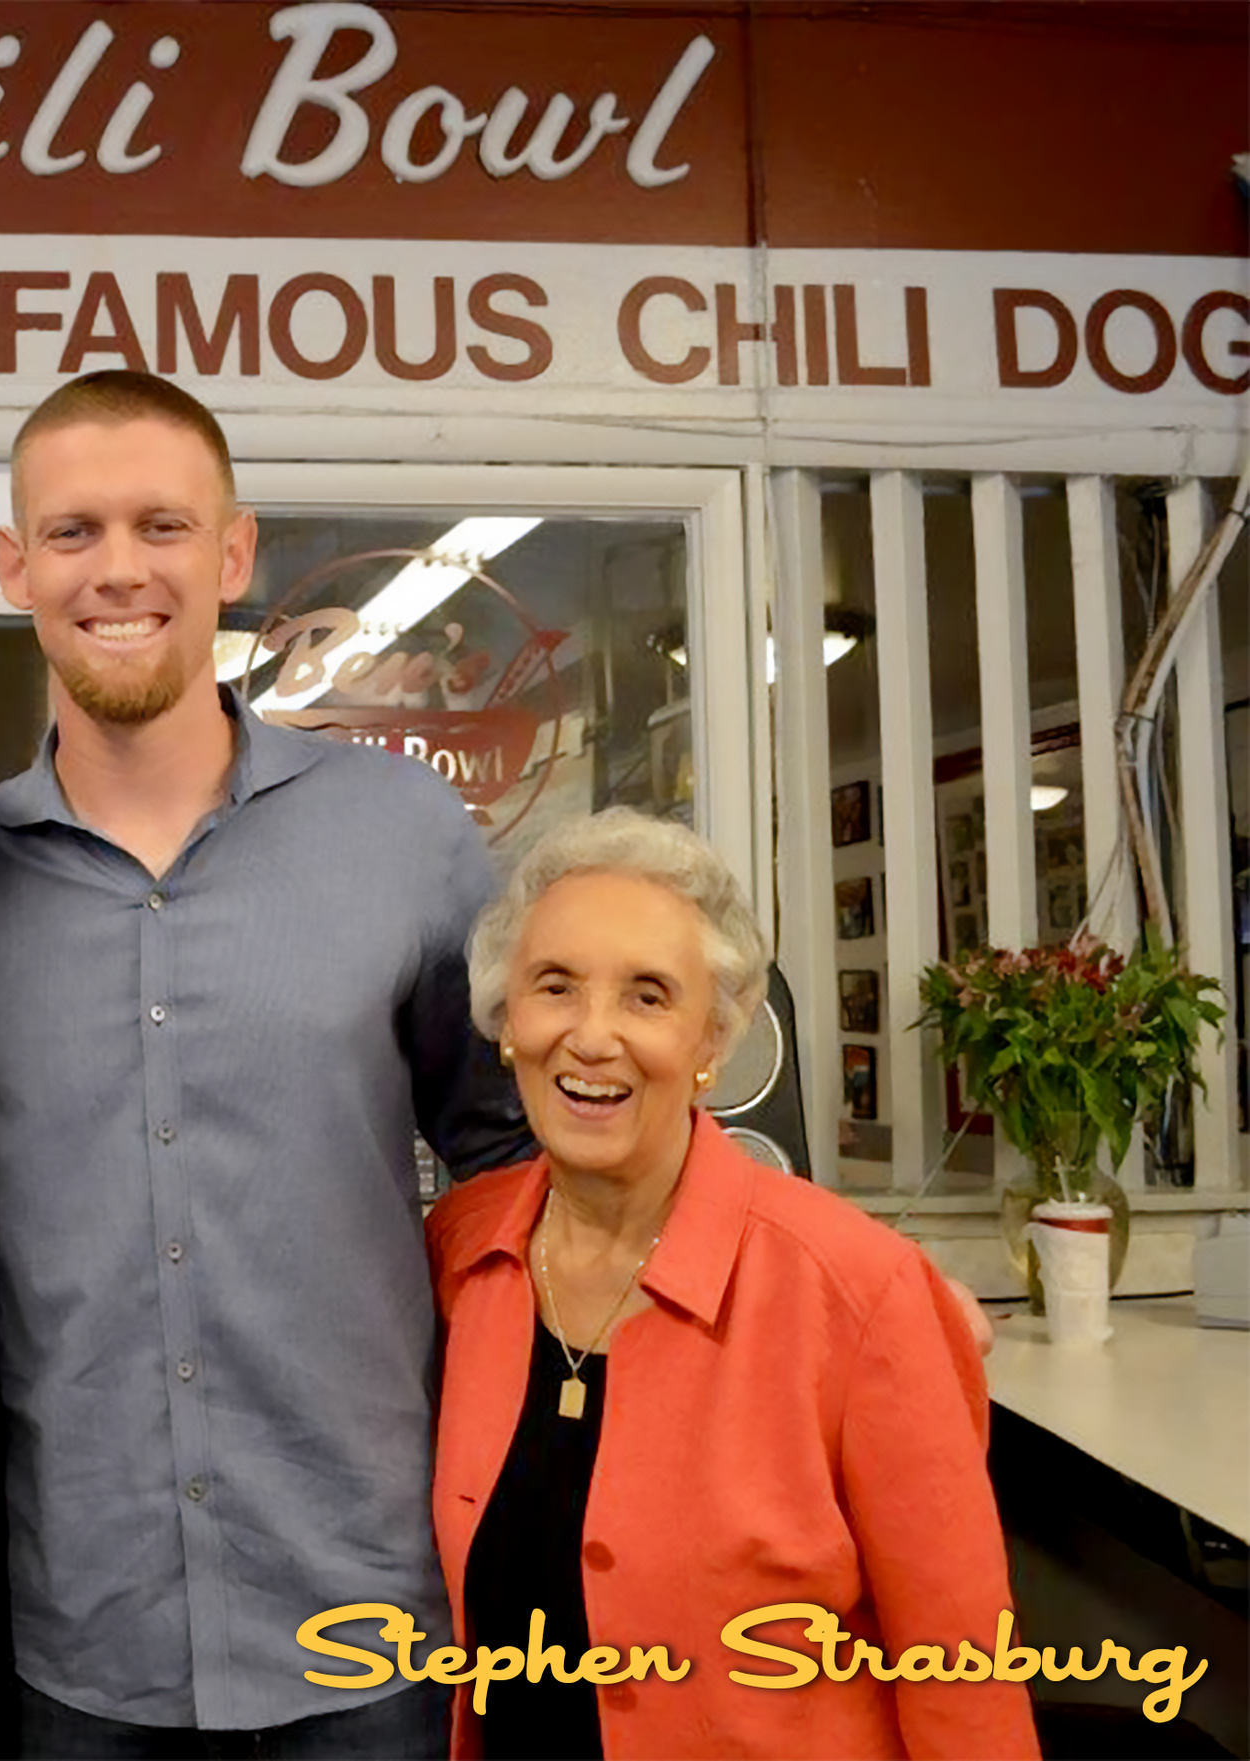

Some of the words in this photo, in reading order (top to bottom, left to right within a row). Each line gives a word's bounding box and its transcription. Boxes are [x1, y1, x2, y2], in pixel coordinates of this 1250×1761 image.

[240, 1, 715, 187] Bowl
[616, 275, 932, 387] CHILI
[992, 287, 1250, 395] DOG
